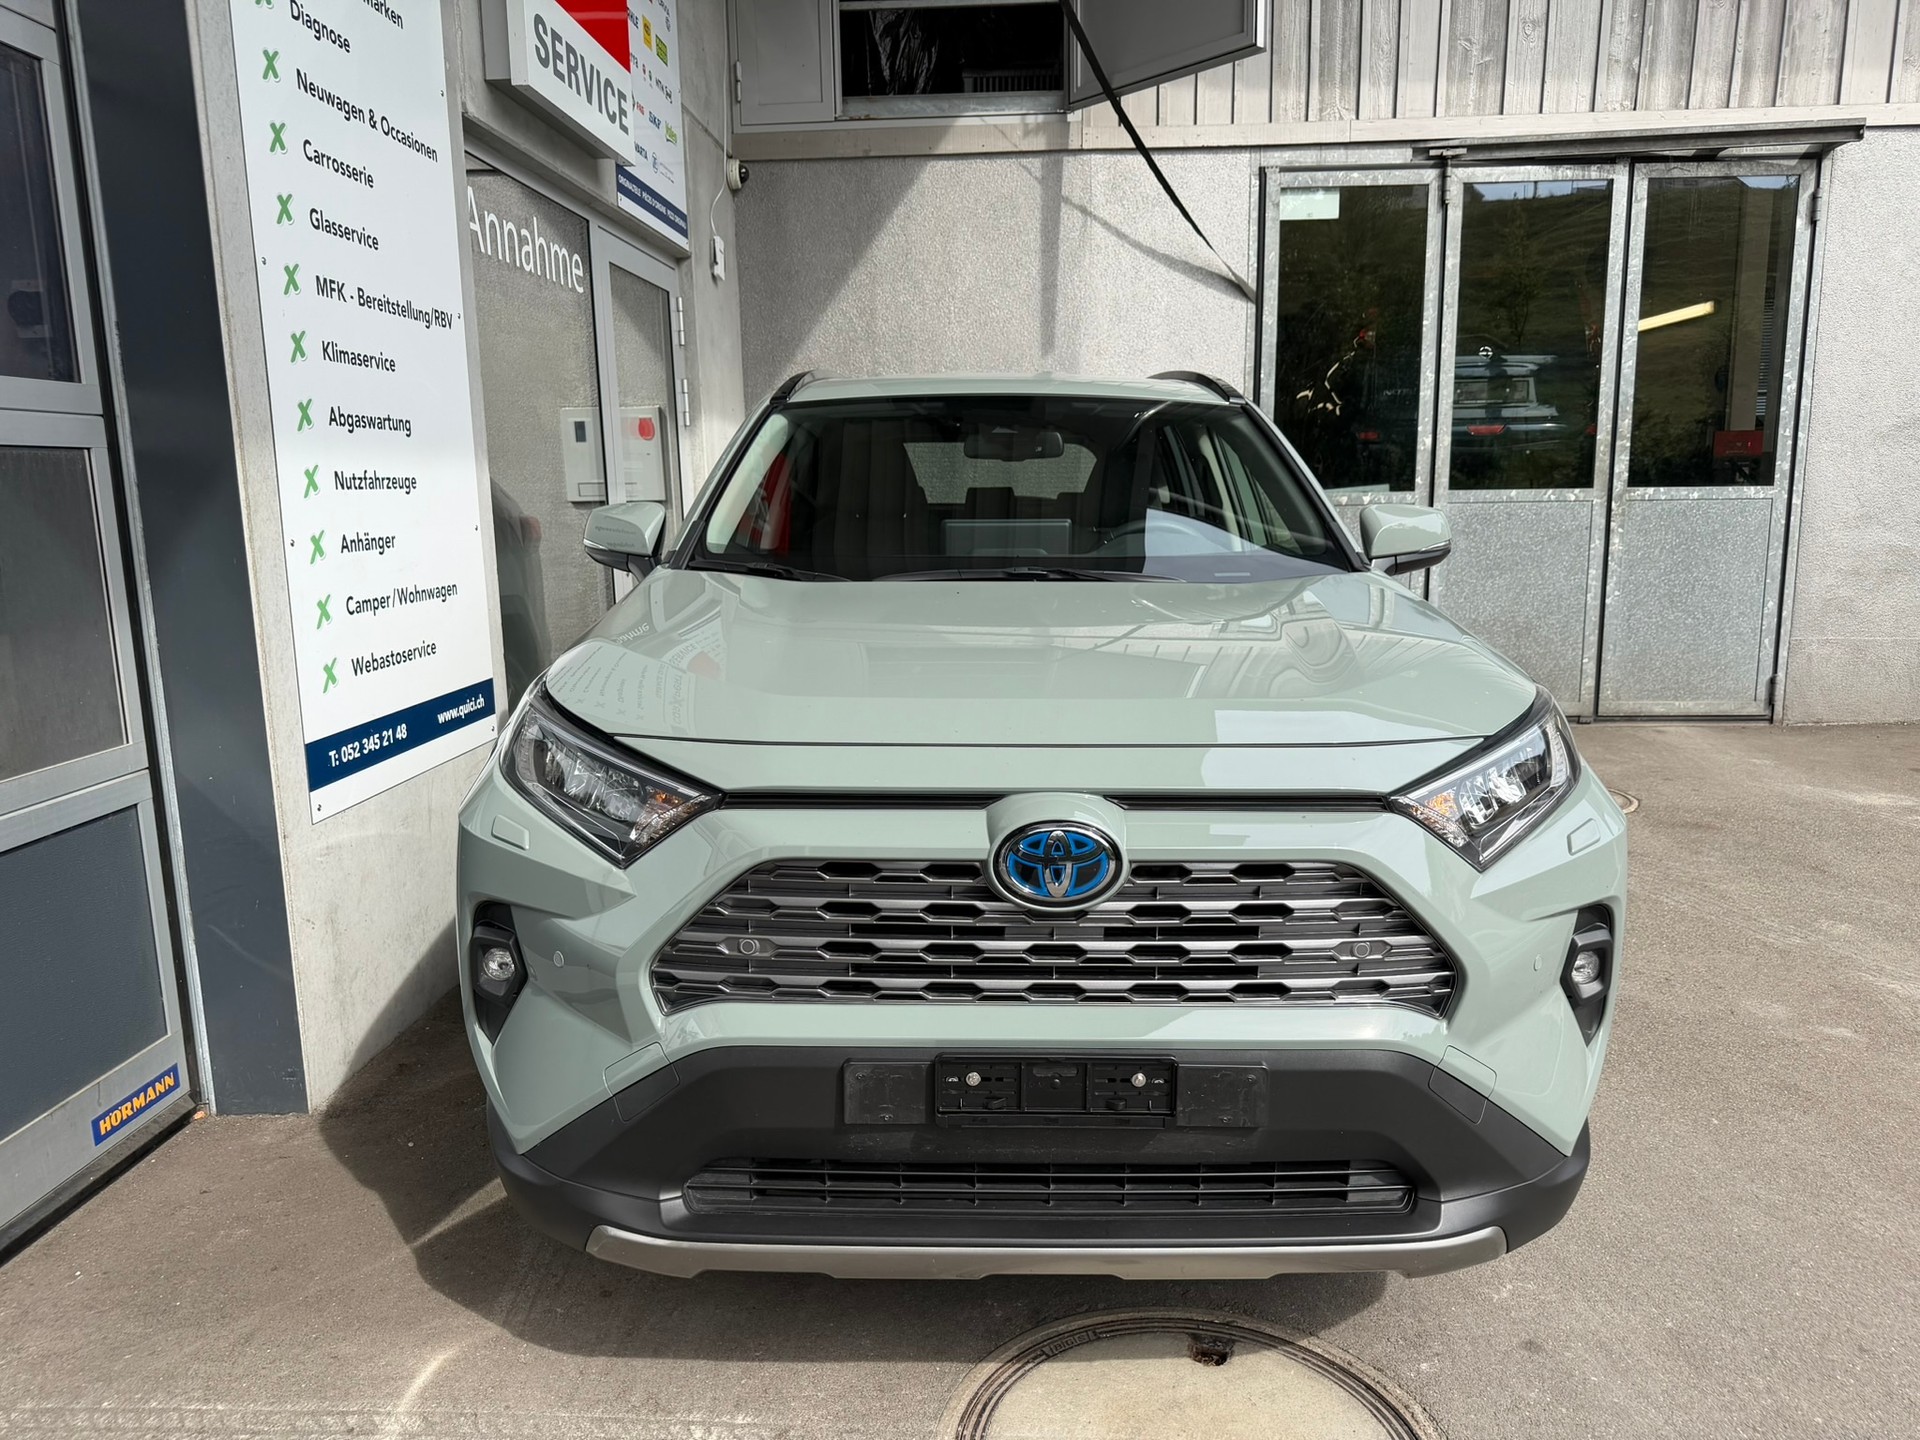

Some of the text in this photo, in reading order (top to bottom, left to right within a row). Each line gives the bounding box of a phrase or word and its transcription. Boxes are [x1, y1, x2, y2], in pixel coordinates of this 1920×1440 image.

[290, 0, 350, 53] Diagnose
[533, 13, 629, 136] SERVICE
[296, 68, 438, 163] Neuwagen & Occasionen
[303, 139, 374, 188] Carrosserie
[309, 208, 379, 250] Glasservice
[467, 185, 584, 294] Annahme
[315, 275, 347, 303] MFK
[357, 287, 453, 329] Bereitstellung/RBV
[321, 340, 396, 372] Klimaservice
[329, 406, 412, 438] Abgaswartung
[334, 470, 417, 495] Nutzfahrzeuge
[340, 532, 396, 555] Anhänger
[351, 640, 437, 677] Webastoservice
[437, 693, 485, 724] www.quici.ch
[329, 723, 407, 768] T: 052 345 21 48
[99, 1072, 175, 1136] HÖRMANN
